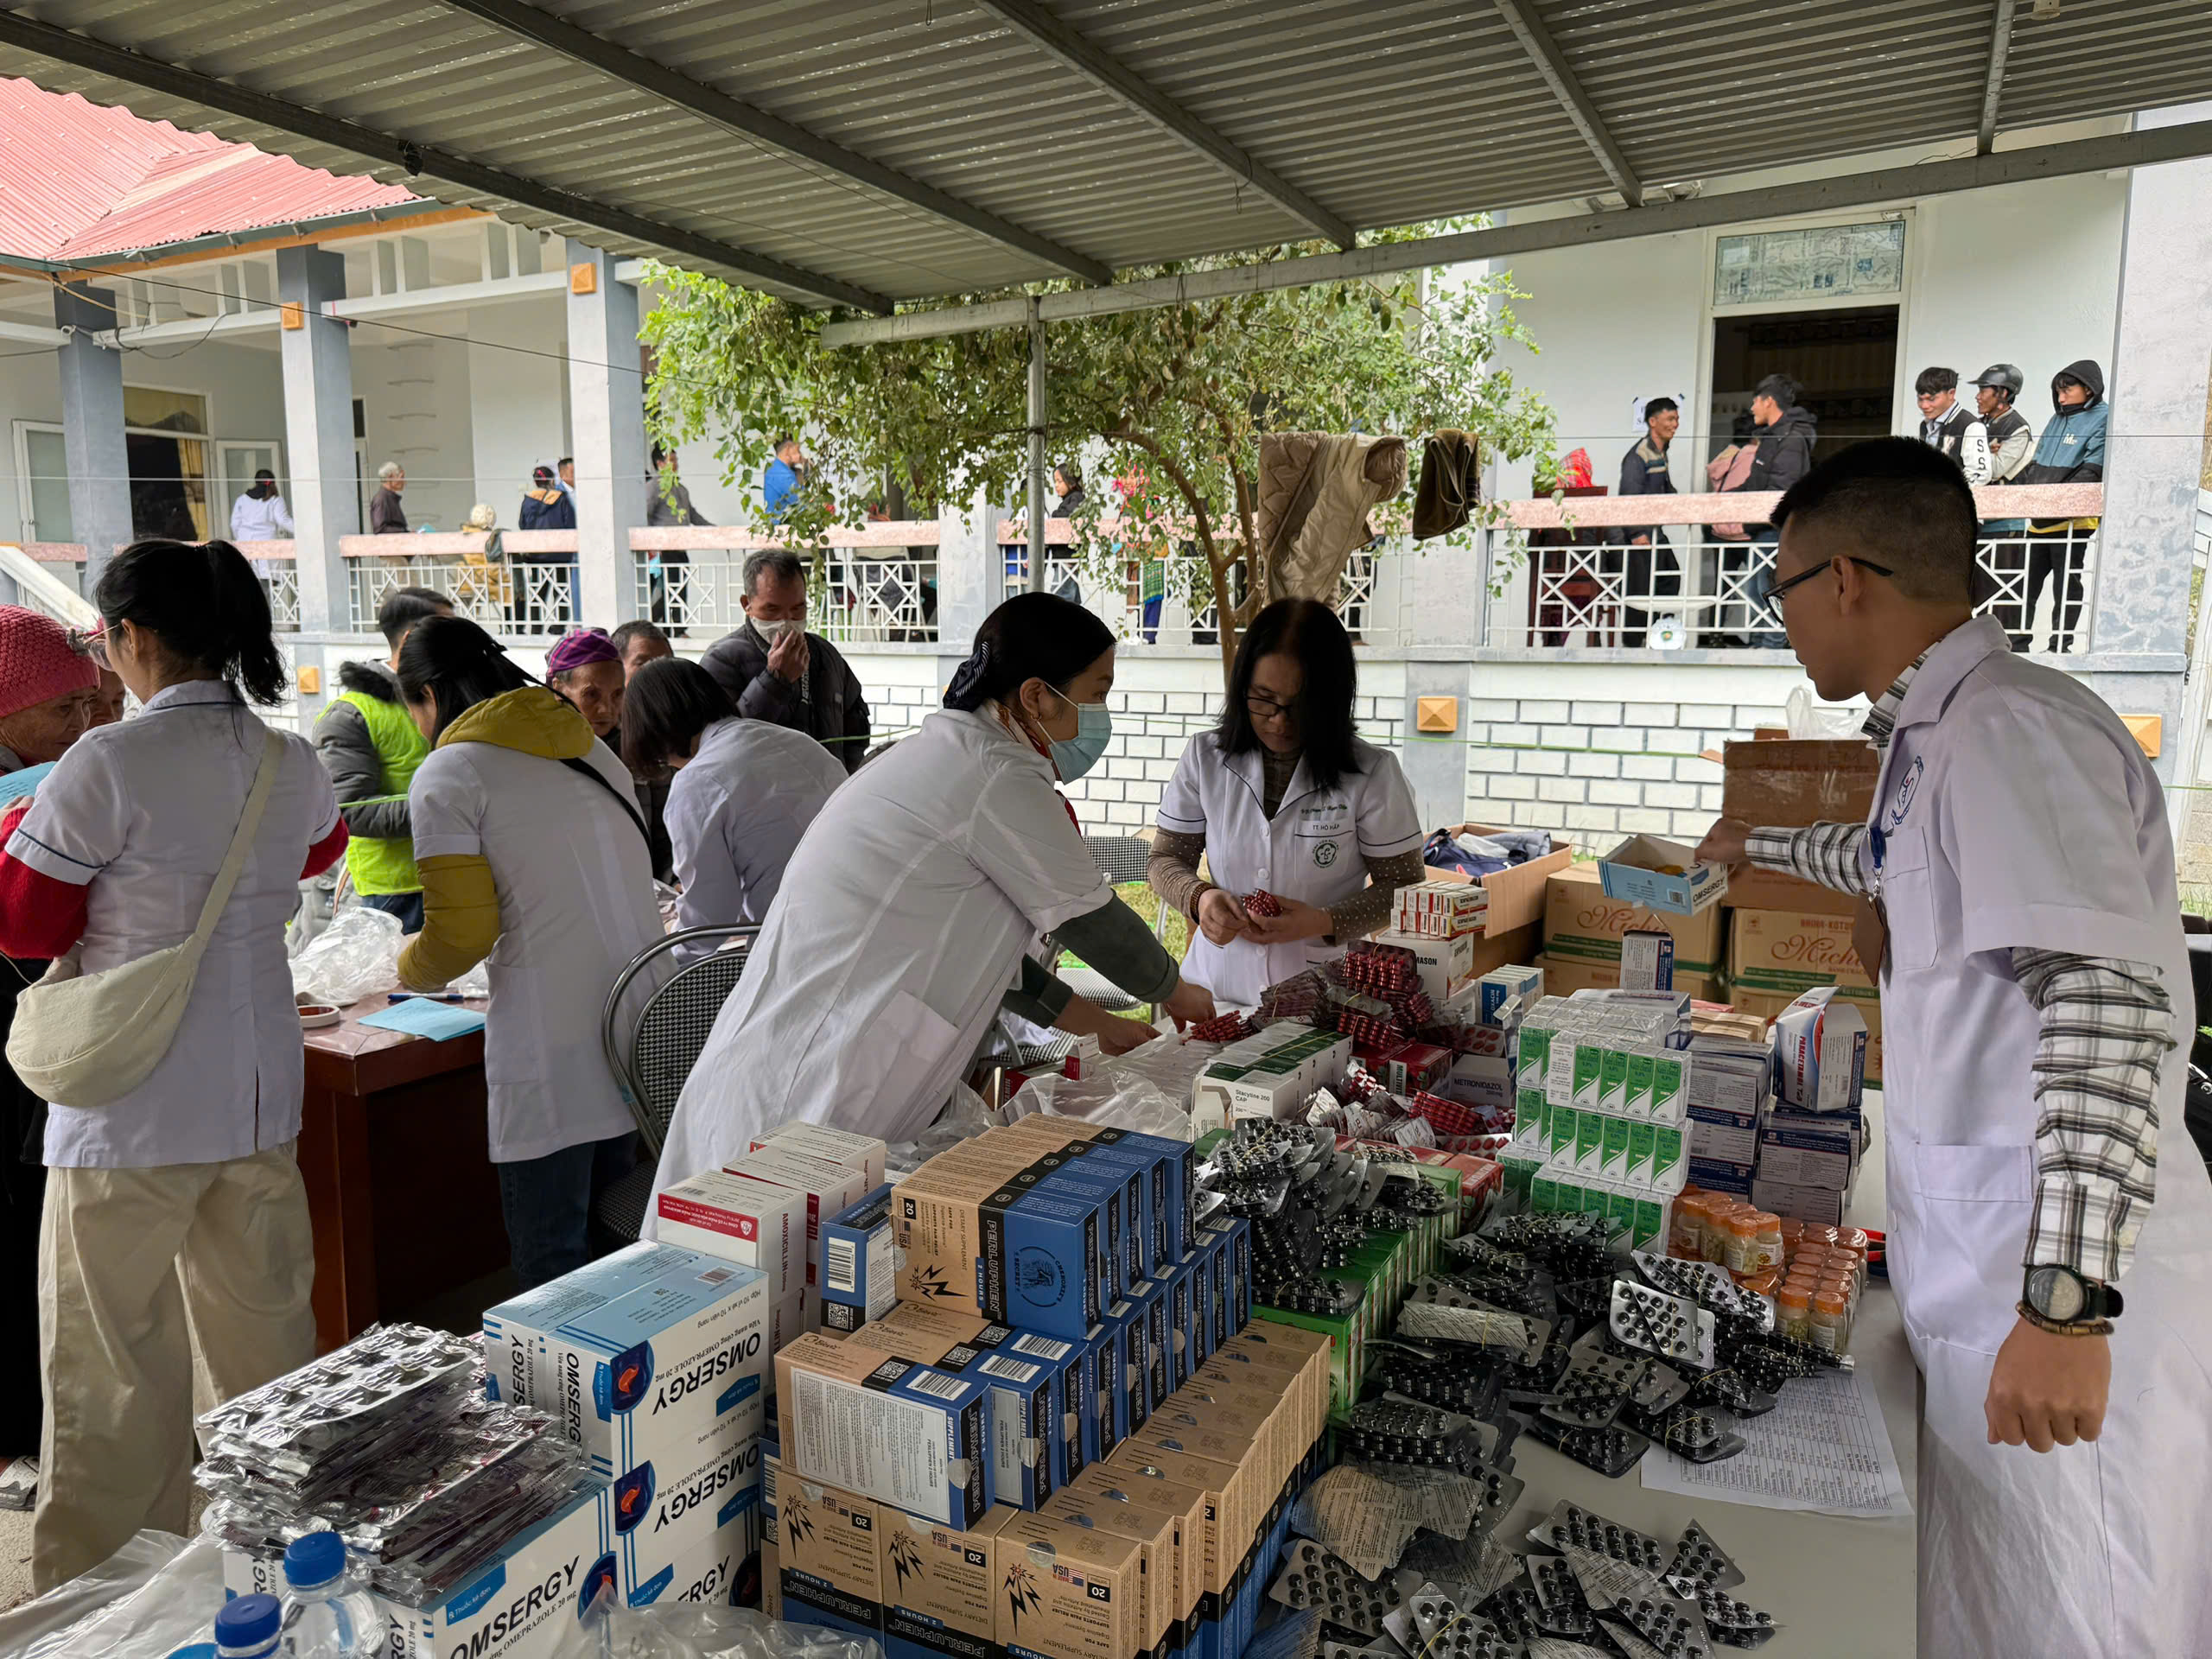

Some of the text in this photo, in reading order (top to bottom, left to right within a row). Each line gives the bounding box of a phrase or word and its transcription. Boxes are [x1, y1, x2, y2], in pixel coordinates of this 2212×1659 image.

[1977, 439, 1985, 452] S
[1978, 457, 1986, 470] S
[1693, 876, 1725, 903] OMSERGY
[1797, 1035, 1806, 1088] PARACETAMOL
[1454, 1078, 1503, 1090] METRONIDAZOL
[906, 1202, 914, 1215] 20
[899, 1233, 907, 1249] USA
[988, 1220, 1000, 1312] PERLUPHEN
[749, 1288, 761, 1300] Hộp
[697, 1316, 709, 1328] nang
[709, 1312, 720, 1321] viên
[747, 1319, 761, 1329] Viên
[734, 1325, 748, 1337] nang
[674, 1342, 720, 1373] OMEPRAZOLE
[652, 1332, 761, 1415] OMSERGY
[655, 1374, 665, 1383] mg
[665, 1370, 674, 1378] 20
[567, 1352, 582, 1443] OMSERG
[719, 1423, 727, 1432] 10
[947, 1415, 956, 1460] SUPPLEMENT
[675, 1453, 721, 1490] OMEPRAZOLE
[653, 1444, 760, 1533] OMSERGY
[666, 1486, 675, 1495] 20
[656, 1491, 667, 1500] mg
[822, 1495, 836, 1508] USA
[855, 1516, 868, 1528] 20
[931, 1530, 947, 1544] USA
[849, 1545, 873, 1554] SUPPORTS
[969, 1553, 982, 1563] 20
[817, 1562, 874, 1587] DIETARY SUPPLEMENT
[1052, 1562, 1069, 1577] USA
[795, 1571, 818, 1586] HOURS
[962, 1580, 987, 1592] SUPPORTS
[1091, 1586, 1105, 1598] 20
[454, 1586, 493, 1616] Thuốc kê đơn
[790, 1580, 872, 1619] PERLUPHEN
[449, 1555, 580, 1659] OMSERGY
[926, 1601, 988, 1624] DIETARY SUPPLEMENT
[1064, 1602, 1084, 1611] Arthritis
[504, 1591, 577, 1649] OMEPRAZOLE 20 mg
[901, 1609, 928, 1623] HOURS
[1052, 1608, 1109, 1628] SUPPORTS PAIN RELIEF
[1091, 1611, 1109, 1620] Caused
[894, 1618, 985, 1657] PERLUPHEN
[1086, 1628, 1109, 1640] Digestive
[1043, 1637, 1083, 1656] SUPPLEMENT
